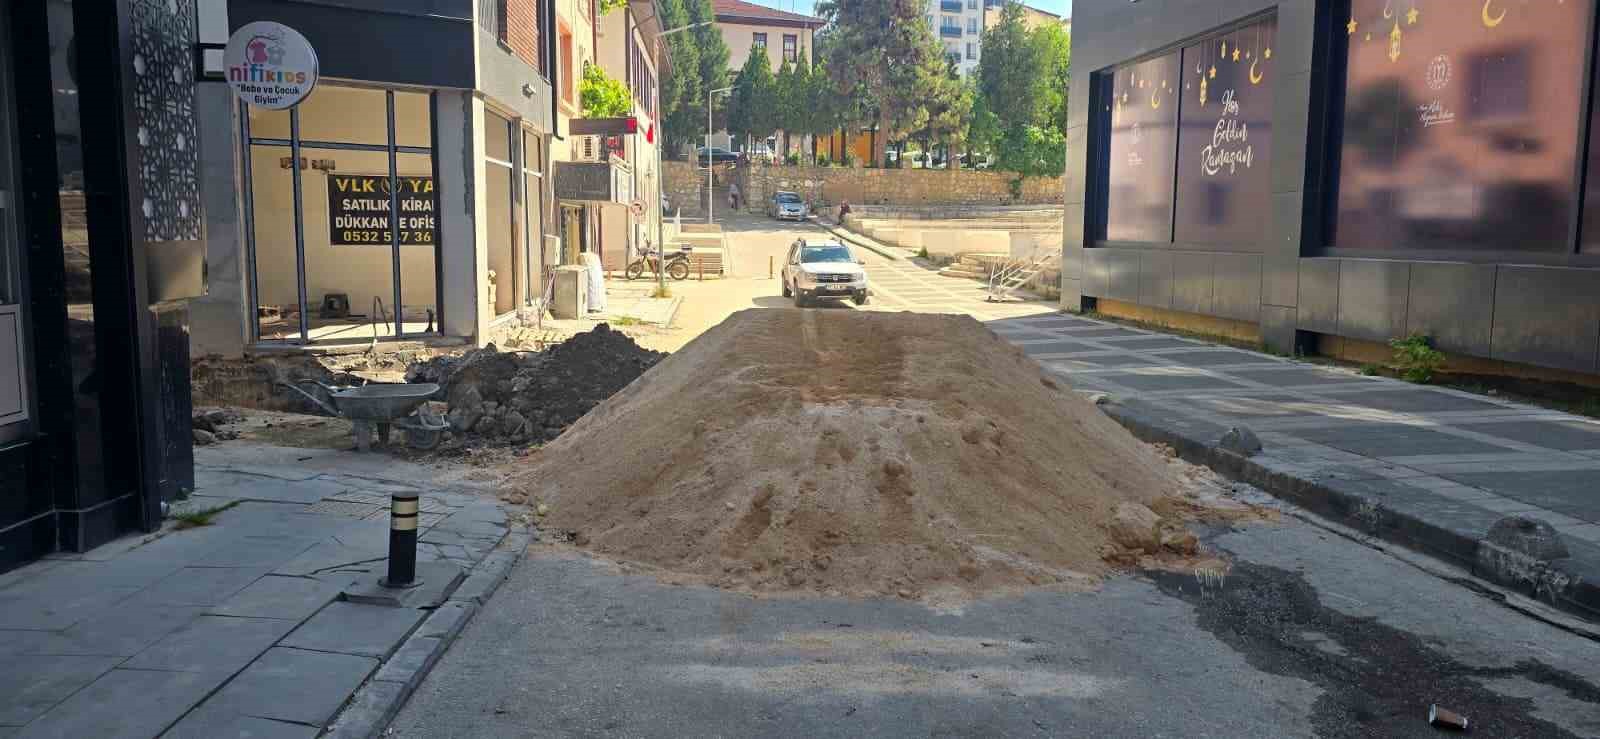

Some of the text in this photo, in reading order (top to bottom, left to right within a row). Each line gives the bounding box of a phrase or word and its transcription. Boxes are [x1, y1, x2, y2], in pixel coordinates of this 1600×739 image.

[336, 178, 375, 192] VLK
[342, 198, 390, 211] SATILIK
[335, 214, 388, 228] DÜKKAN
[343, 231, 431, 242] 0532 57 36
